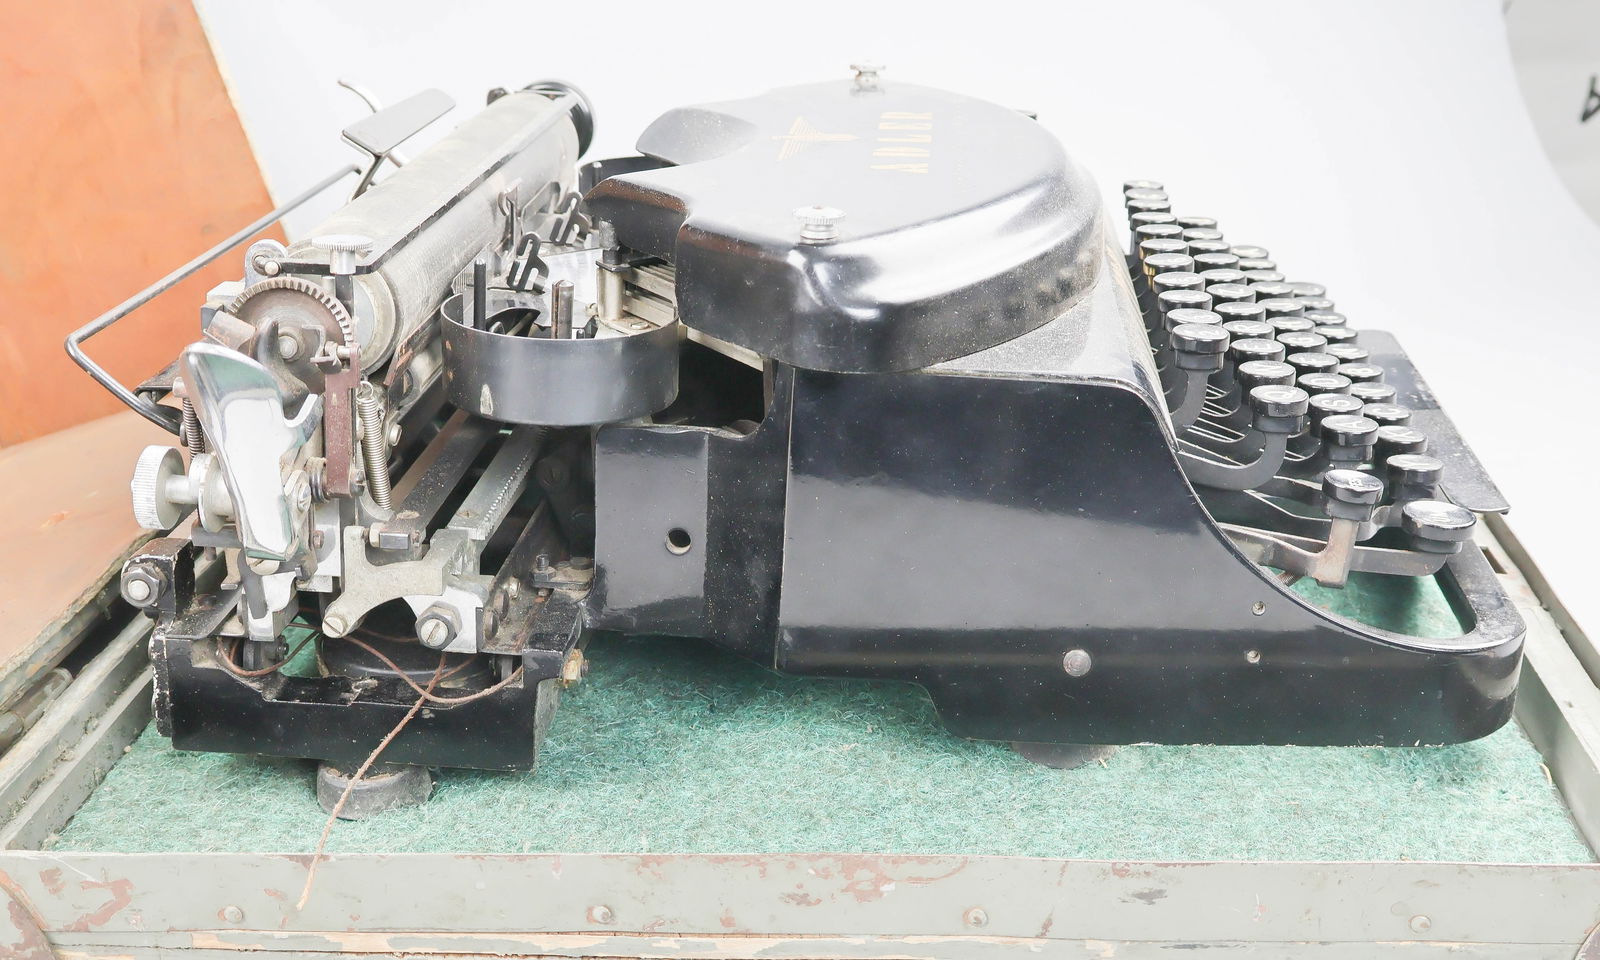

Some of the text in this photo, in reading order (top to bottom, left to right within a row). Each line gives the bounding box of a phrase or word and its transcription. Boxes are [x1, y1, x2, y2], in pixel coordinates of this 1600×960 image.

[869, 111, 934, 174] ADLER
[1235, 323, 1260, 331] R
[1244, 343, 1270, 351] E
[1265, 389, 1297, 398] Q
[1321, 398, 1351, 407] S
[1335, 420, 1363, 428] A
